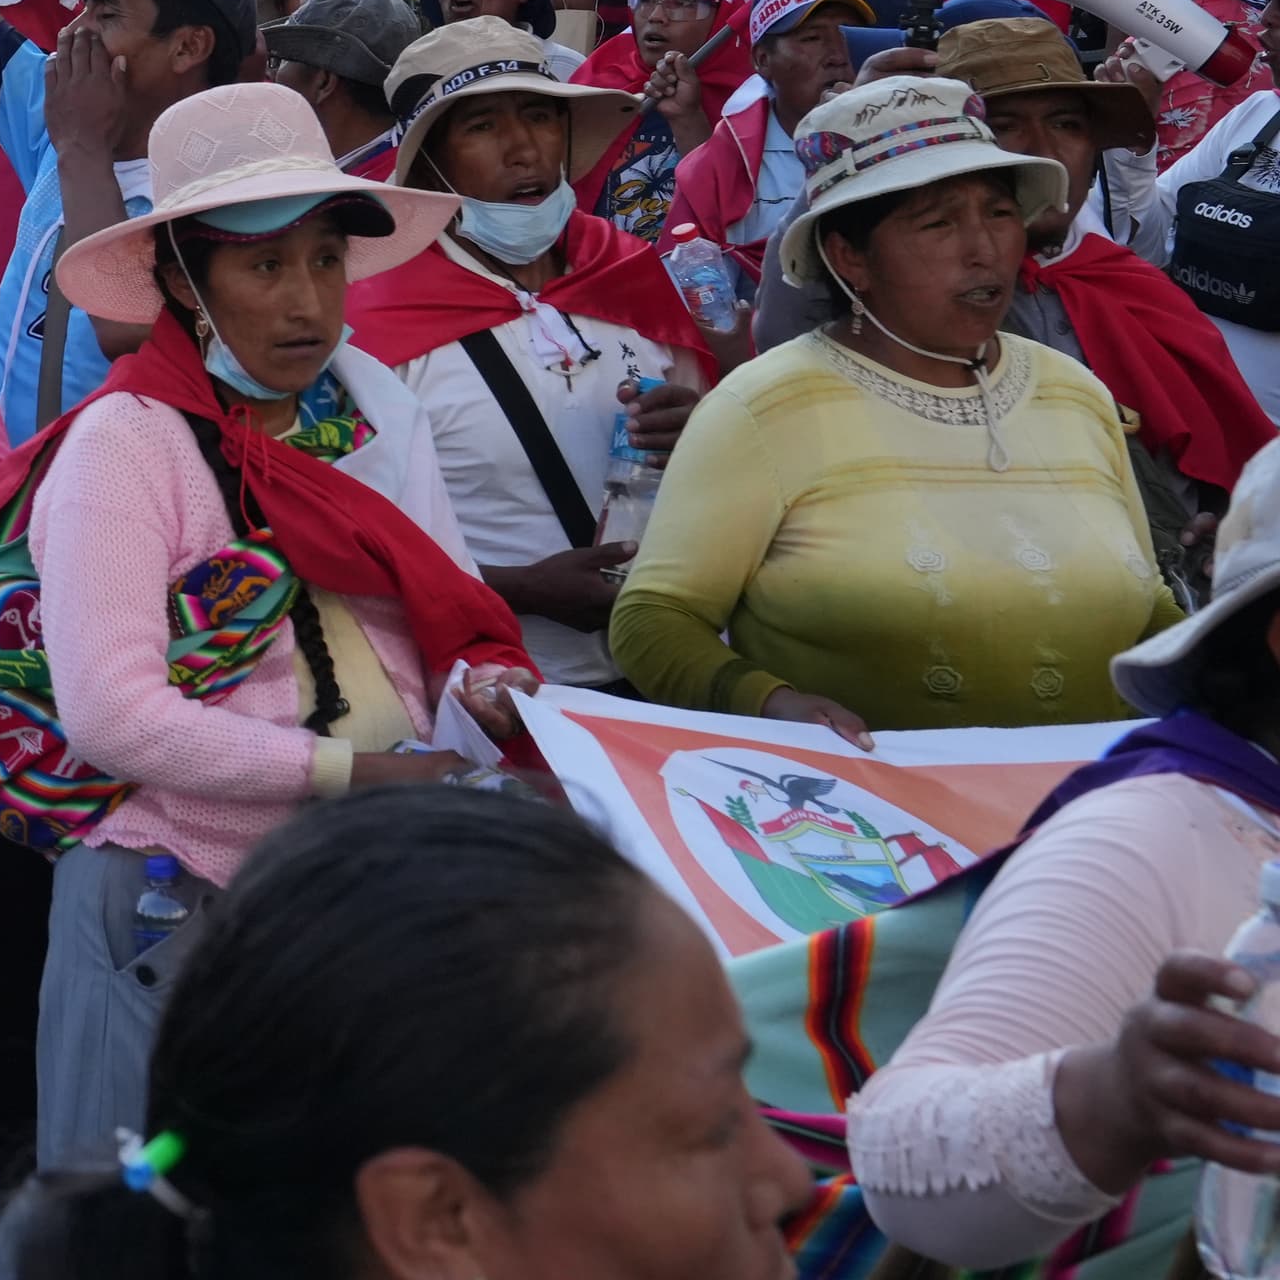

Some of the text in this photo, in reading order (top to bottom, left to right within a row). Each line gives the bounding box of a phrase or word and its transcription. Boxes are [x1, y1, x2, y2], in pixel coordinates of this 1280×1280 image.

[1139, 0, 1161, 17] ATK
[1156, 14, 1184, 35] 35W
[1194, 202, 1253, 228] adidas
[1174, 263, 1233, 300] adidas
